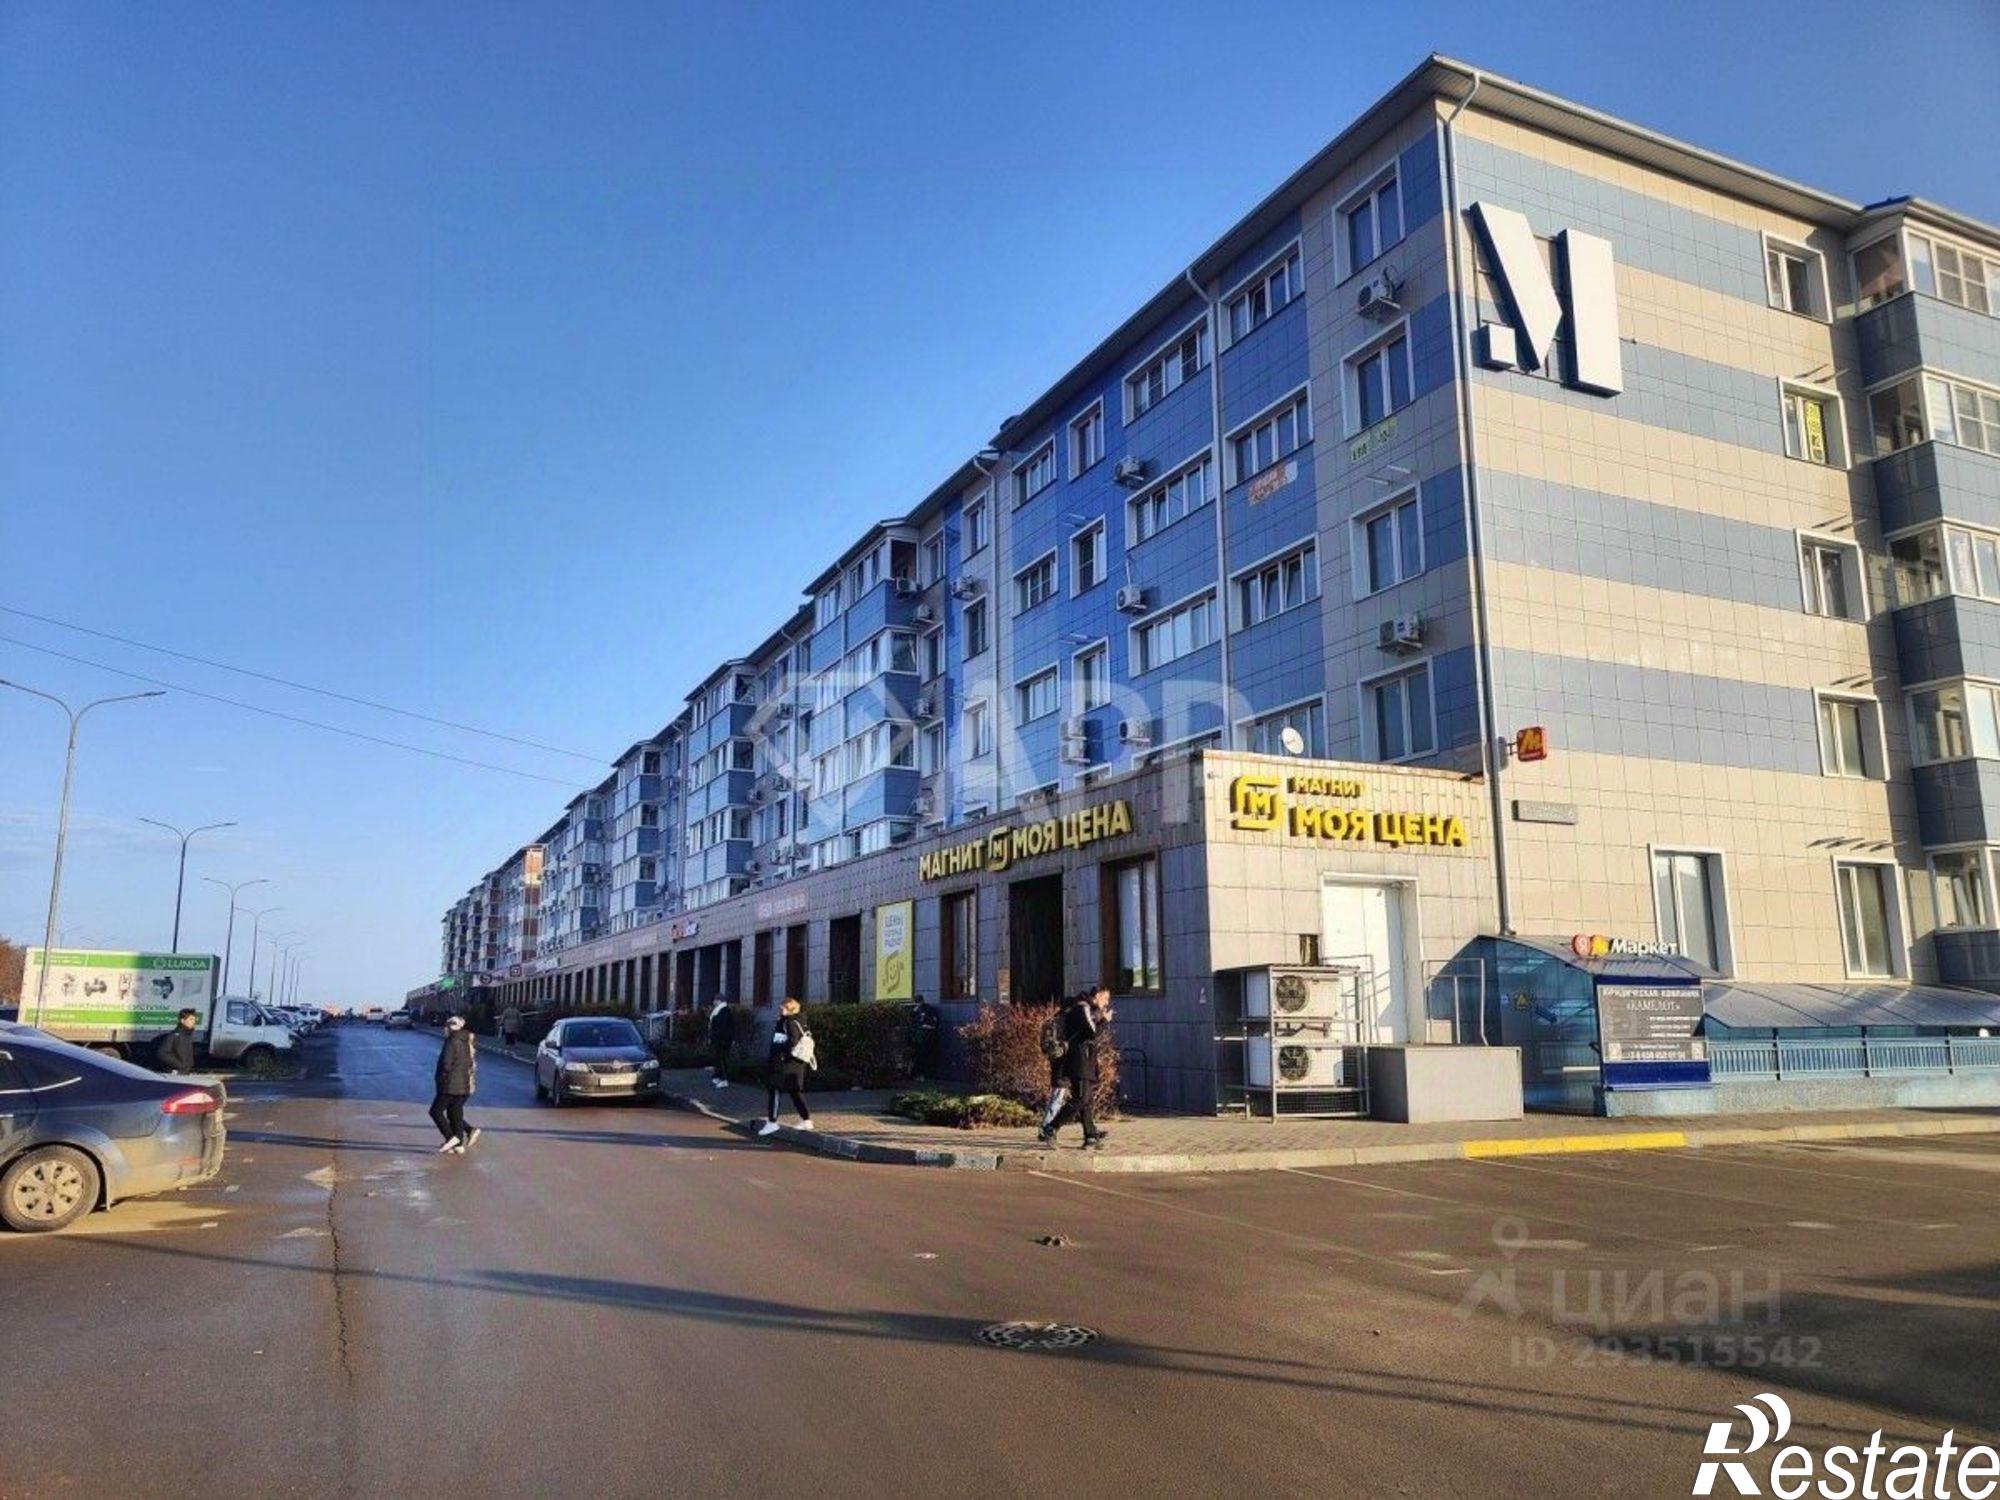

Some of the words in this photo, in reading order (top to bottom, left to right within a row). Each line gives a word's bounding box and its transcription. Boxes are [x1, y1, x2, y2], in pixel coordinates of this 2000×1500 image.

[1295, 778, 1366, 798] МАГНИТ
[1293, 805, 1371, 841] МОЯ
[1379, 812, 1467, 849] ЦЕНА
[918, 838, 985, 882] МАГНИТ
[1012, 819, 1057, 860] МОЯ
[1062, 802, 1132, 849] ЦЕНА
[1610, 938, 1678, 956] Маркет
[166, 958, 207, 969] LUNDA
